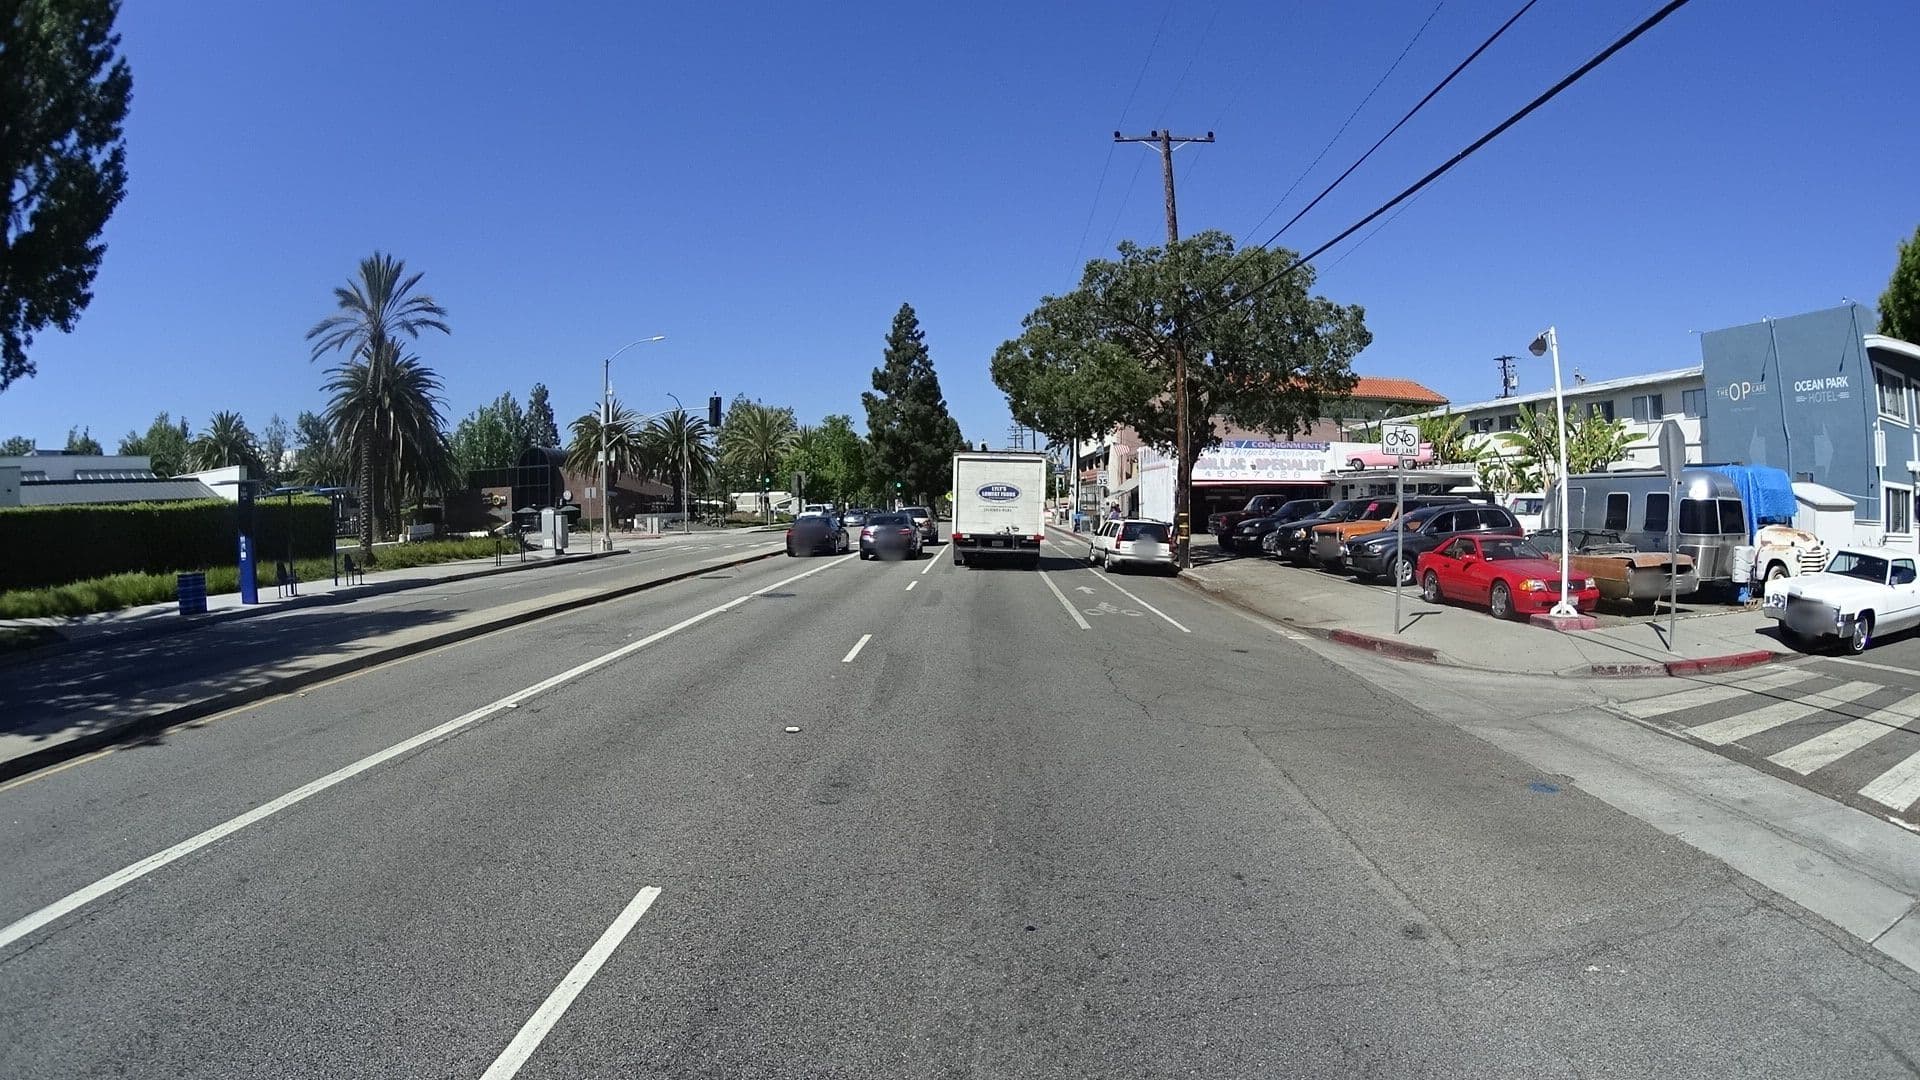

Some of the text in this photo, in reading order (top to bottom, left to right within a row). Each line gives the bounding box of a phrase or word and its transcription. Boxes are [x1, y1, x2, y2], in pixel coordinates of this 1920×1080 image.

[1794, 376, 1849, 392] OCEAN PARK
[1717, 382, 1766, 401] THE OP CAFE
[1808, 391, 1838, 403] HOTEL
[1251, 441, 1326, 449] CONSIGNMENTS
[1255, 458, 1326, 471] SPECIALIST
